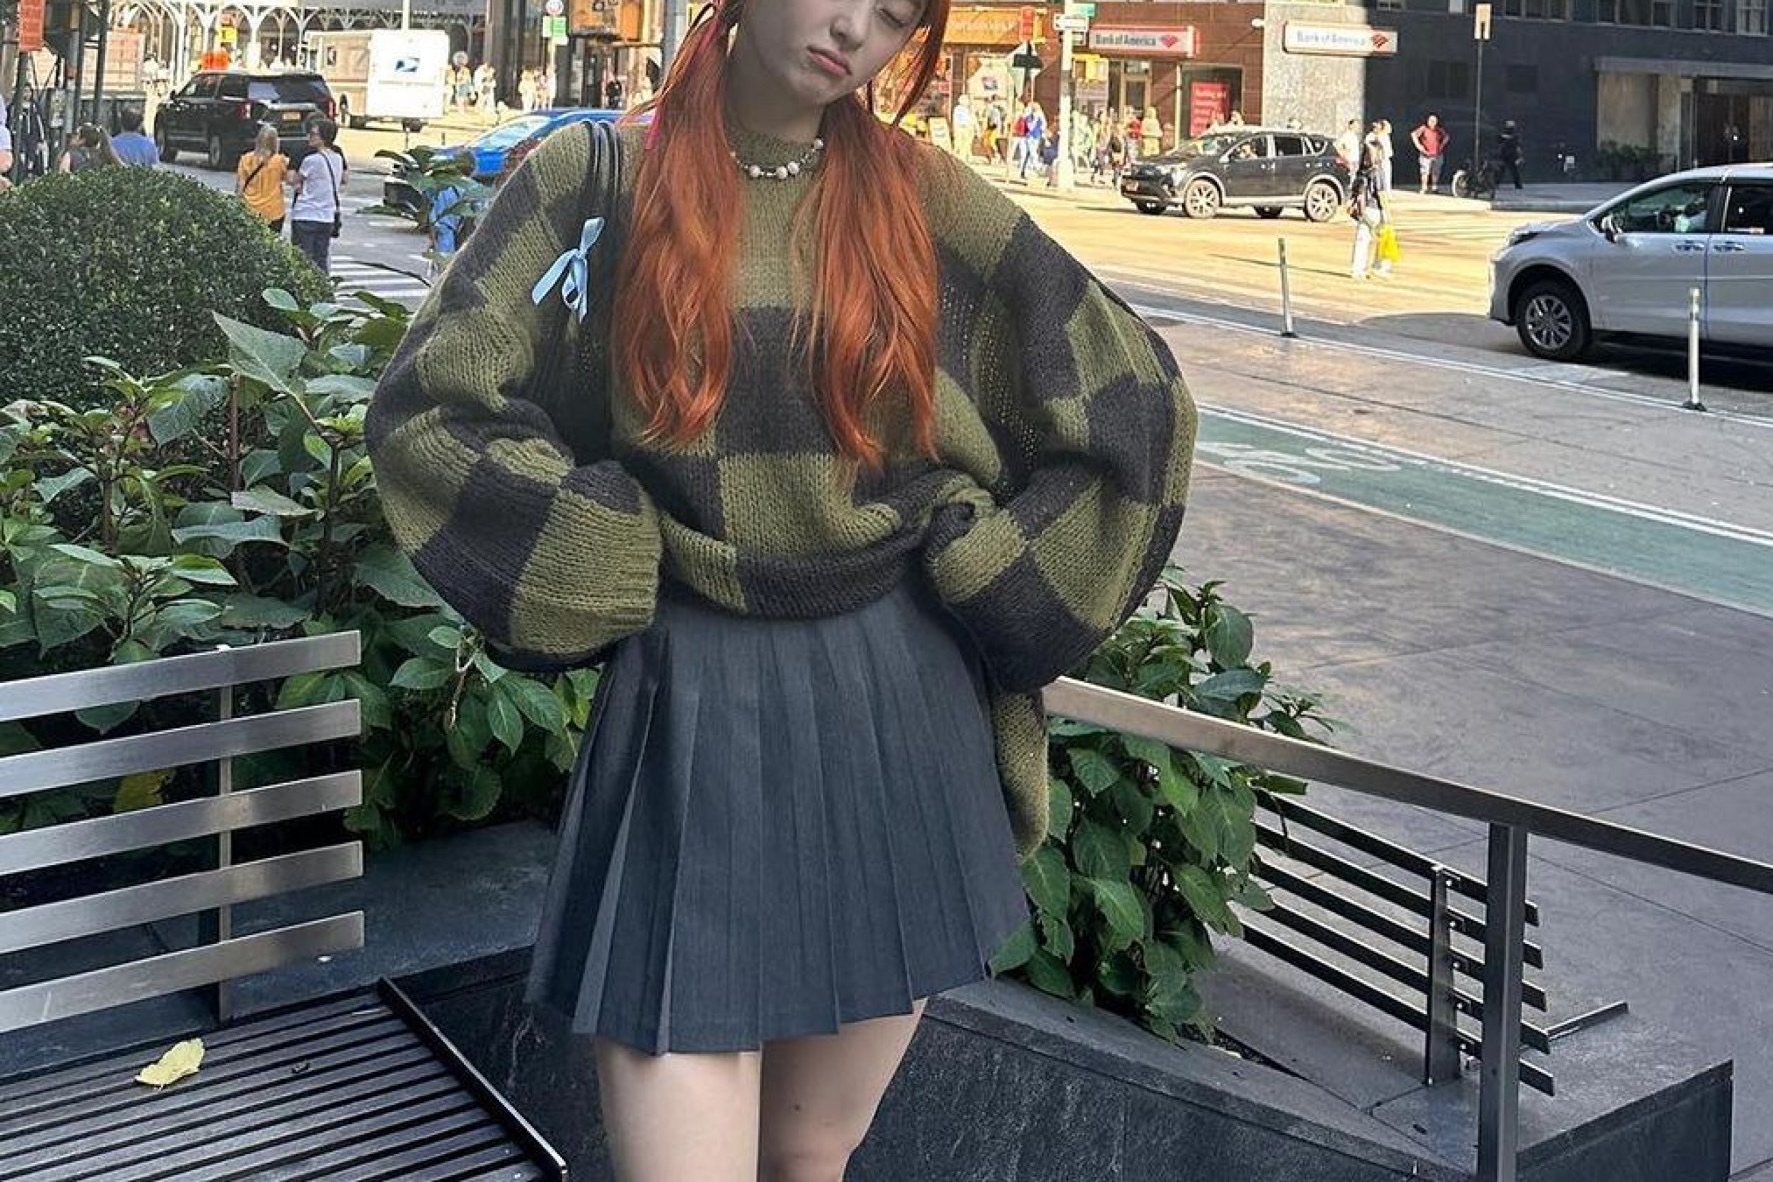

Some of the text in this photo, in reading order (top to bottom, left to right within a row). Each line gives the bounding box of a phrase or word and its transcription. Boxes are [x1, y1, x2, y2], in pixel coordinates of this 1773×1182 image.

[1095, 34, 1157, 47] Bank of America
